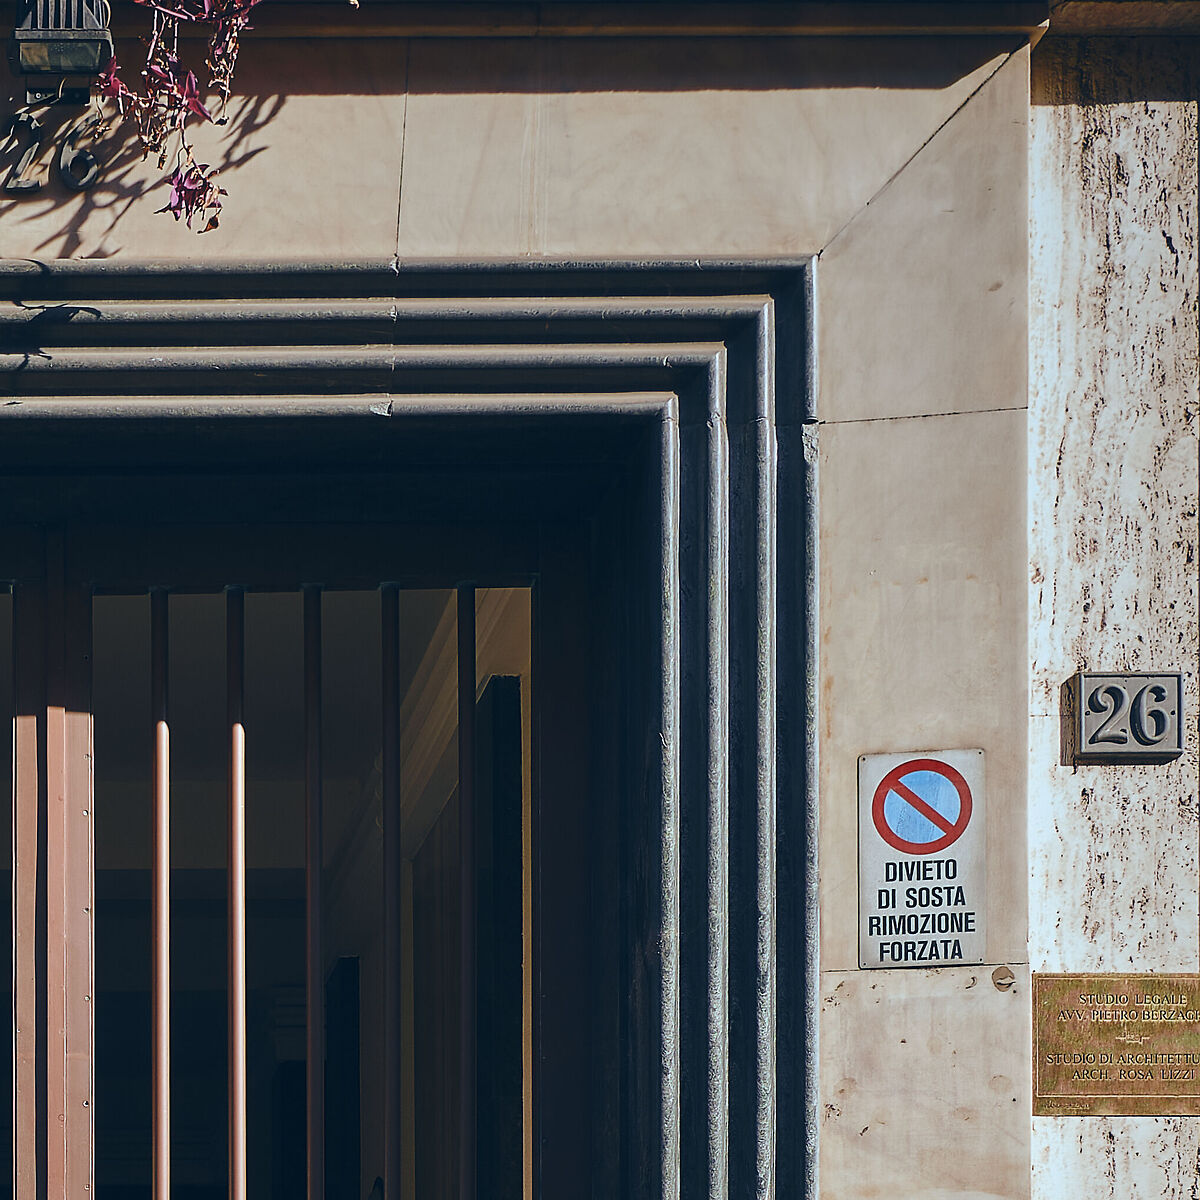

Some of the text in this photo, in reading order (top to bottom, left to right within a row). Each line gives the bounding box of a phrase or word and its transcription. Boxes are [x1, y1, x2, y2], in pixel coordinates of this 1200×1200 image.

[1086, 682, 1172, 746] 26
[884, 859, 958, 883] DIVIETO
[877, 886, 966, 910] DI SOSTA
[868, 912, 976, 937] RIMOZIONE
[879, 940, 963, 962] FORZATA
[1079, 993, 1188, 1006] STUDIO LEGALE
[1057, 1010, 1087, 1021] AVV.
[1091, 1010, 1138, 1021] PIETRO
[1046, 1053, 1096, 1065] STUDIO
[1099, 1053, 1113, 1065] DI
[1072, 1069, 1195, 1081] ARCH. ROSA LIZZI
